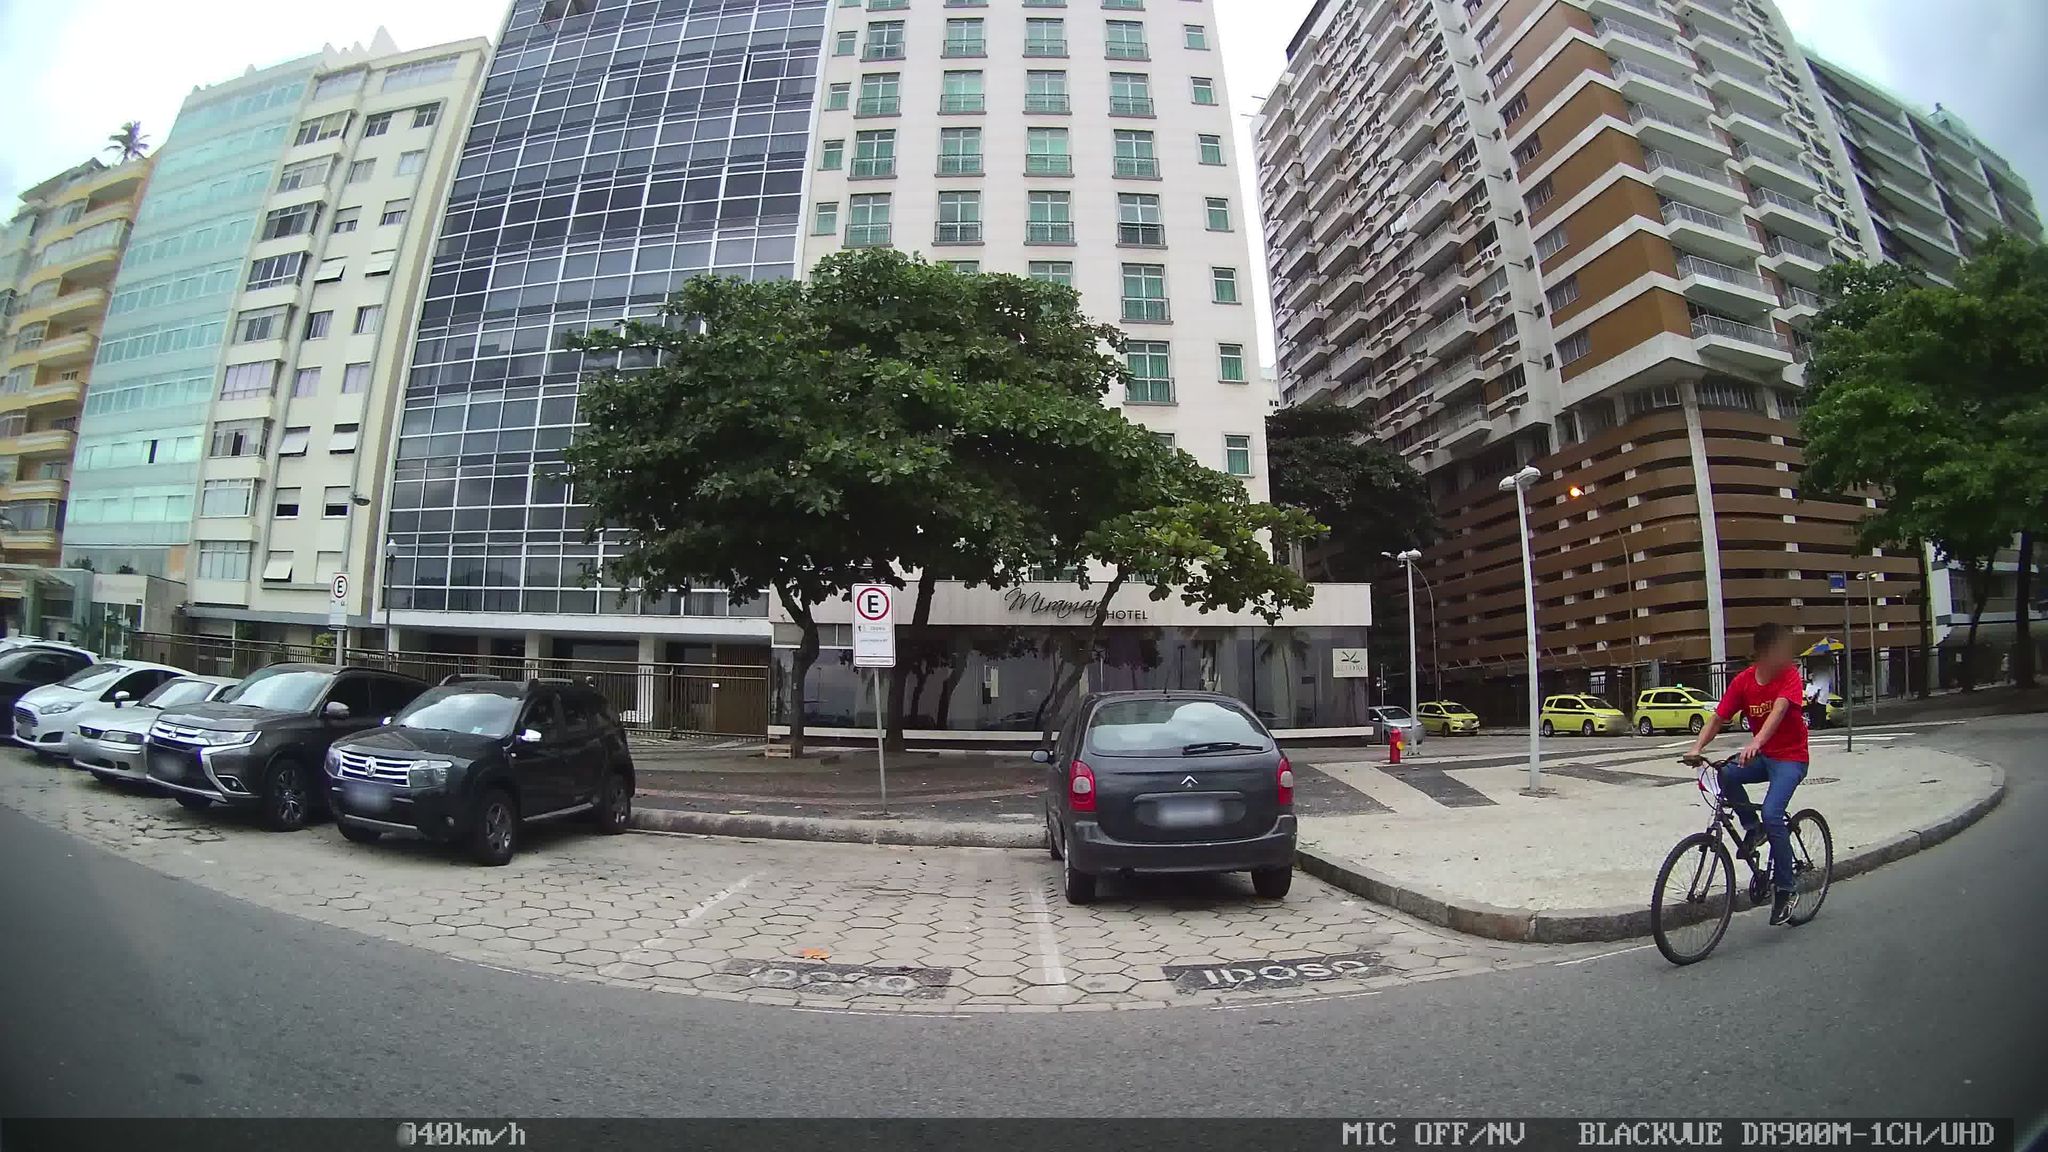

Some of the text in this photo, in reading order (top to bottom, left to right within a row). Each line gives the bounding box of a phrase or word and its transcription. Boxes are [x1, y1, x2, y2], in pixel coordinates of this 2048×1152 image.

[337, 580, 344, 594] E
[867, 594, 879, 614] E
[1004, 587, 1102, 619] Miramar
[1106, 610, 1149, 620] HOTEL
[1202, 959, 1369, 986] IDOSO
